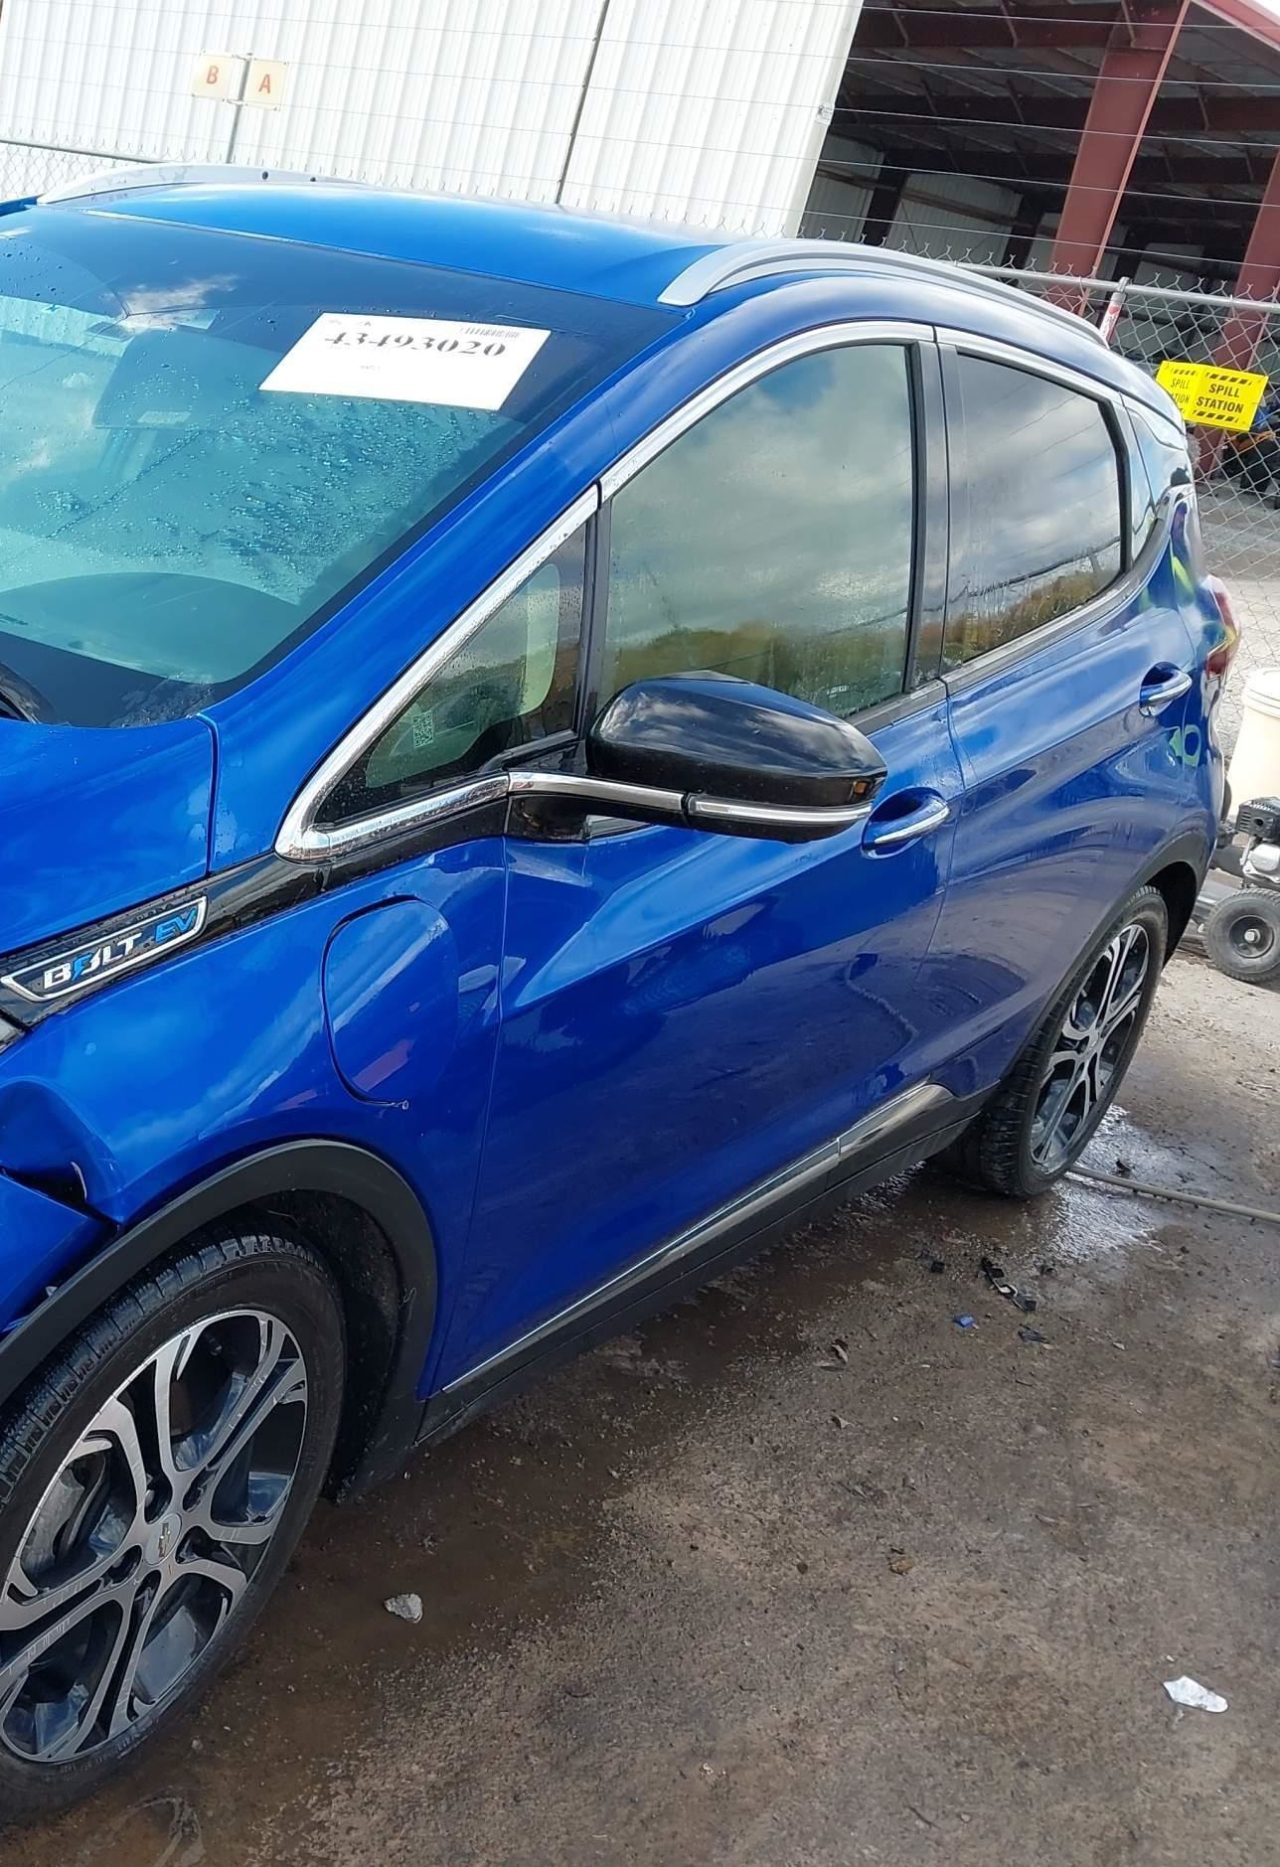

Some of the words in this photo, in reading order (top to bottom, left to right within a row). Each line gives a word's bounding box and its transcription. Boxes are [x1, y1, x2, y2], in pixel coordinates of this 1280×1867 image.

[205, 64, 220, 85] B
[258, 73, 272, 94] A
[324, 331, 507, 357] 43493020
[1170, 377, 1191, 390] SPILL
[1208, 383, 1240, 398] SPILL
[1195, 395, 1245, 414] STATION
[154, 906, 197, 943] EV
